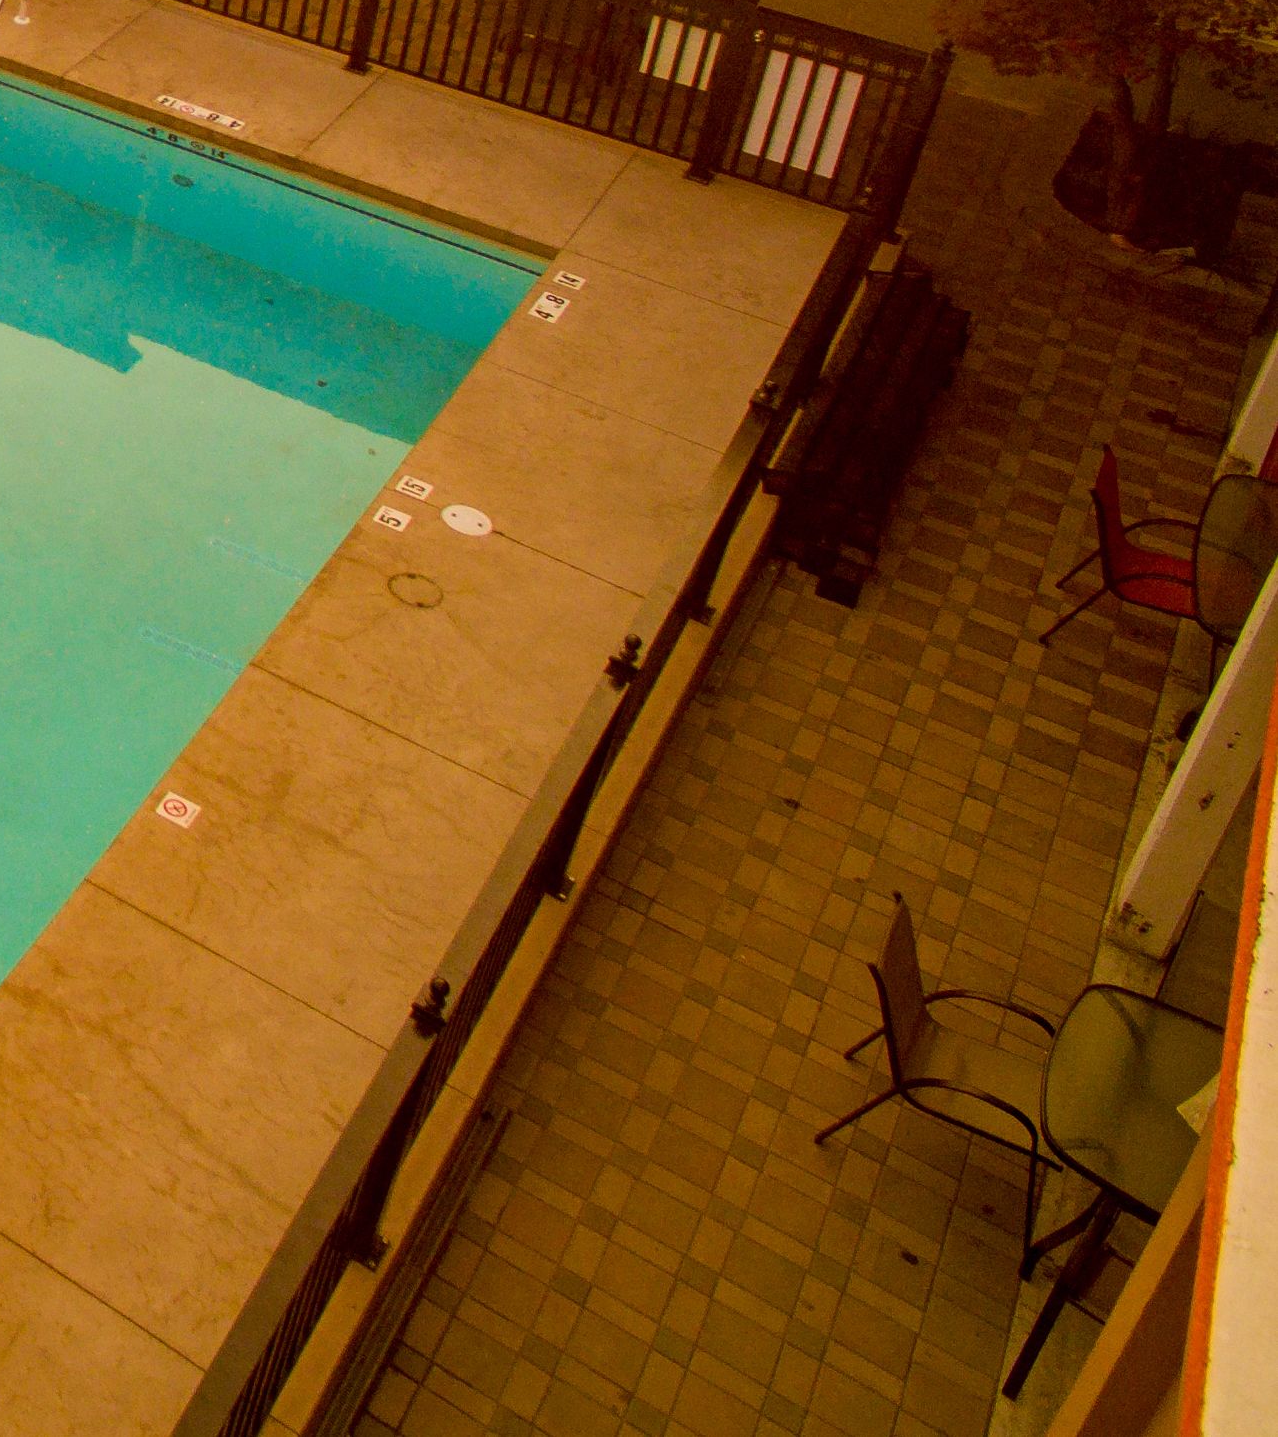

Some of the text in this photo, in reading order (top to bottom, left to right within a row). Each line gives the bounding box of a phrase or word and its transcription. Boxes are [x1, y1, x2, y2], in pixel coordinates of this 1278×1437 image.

[534, 294, 565, 320] 4 8
[379, 513, 402, 528] 5
